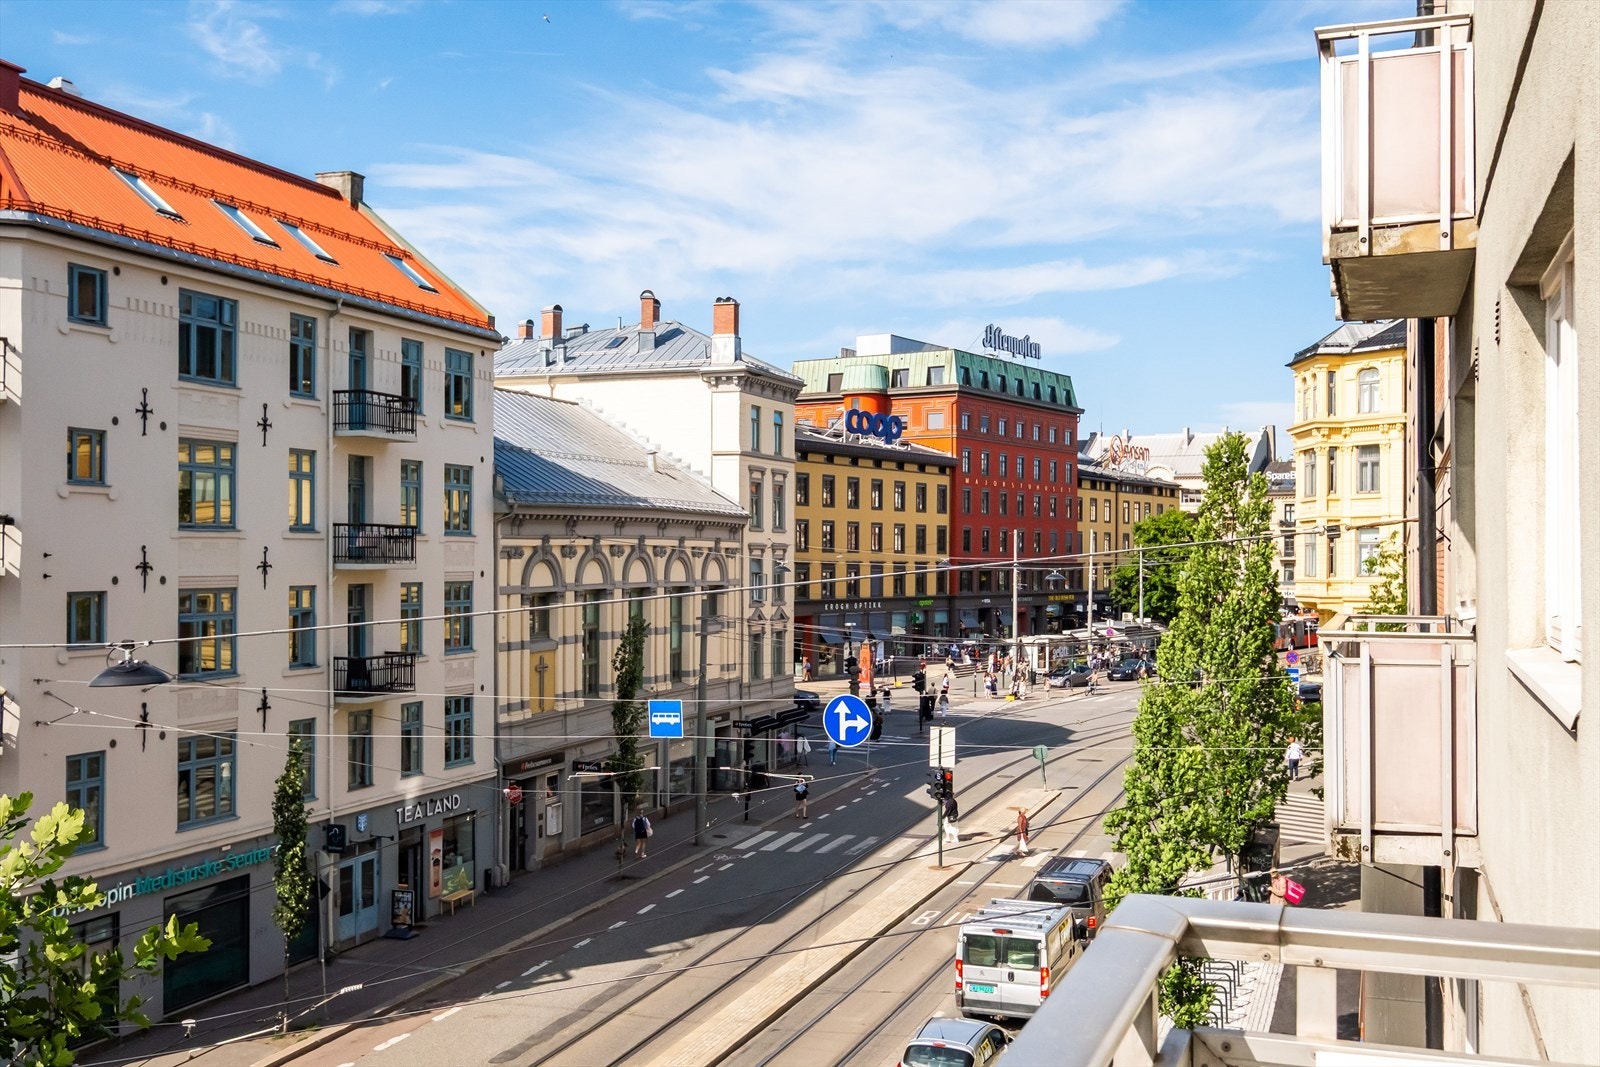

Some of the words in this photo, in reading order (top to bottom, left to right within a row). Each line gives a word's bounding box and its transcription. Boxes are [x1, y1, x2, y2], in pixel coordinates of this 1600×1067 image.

[982, 323, 1041, 360] Aftenposten
[845, 408, 903, 445] coop
[396, 805, 424, 825] TEA
[426, 793, 461, 817] LAND
[135, 858, 222, 896] Medisinske
[226, 846, 272, 871] Senter
